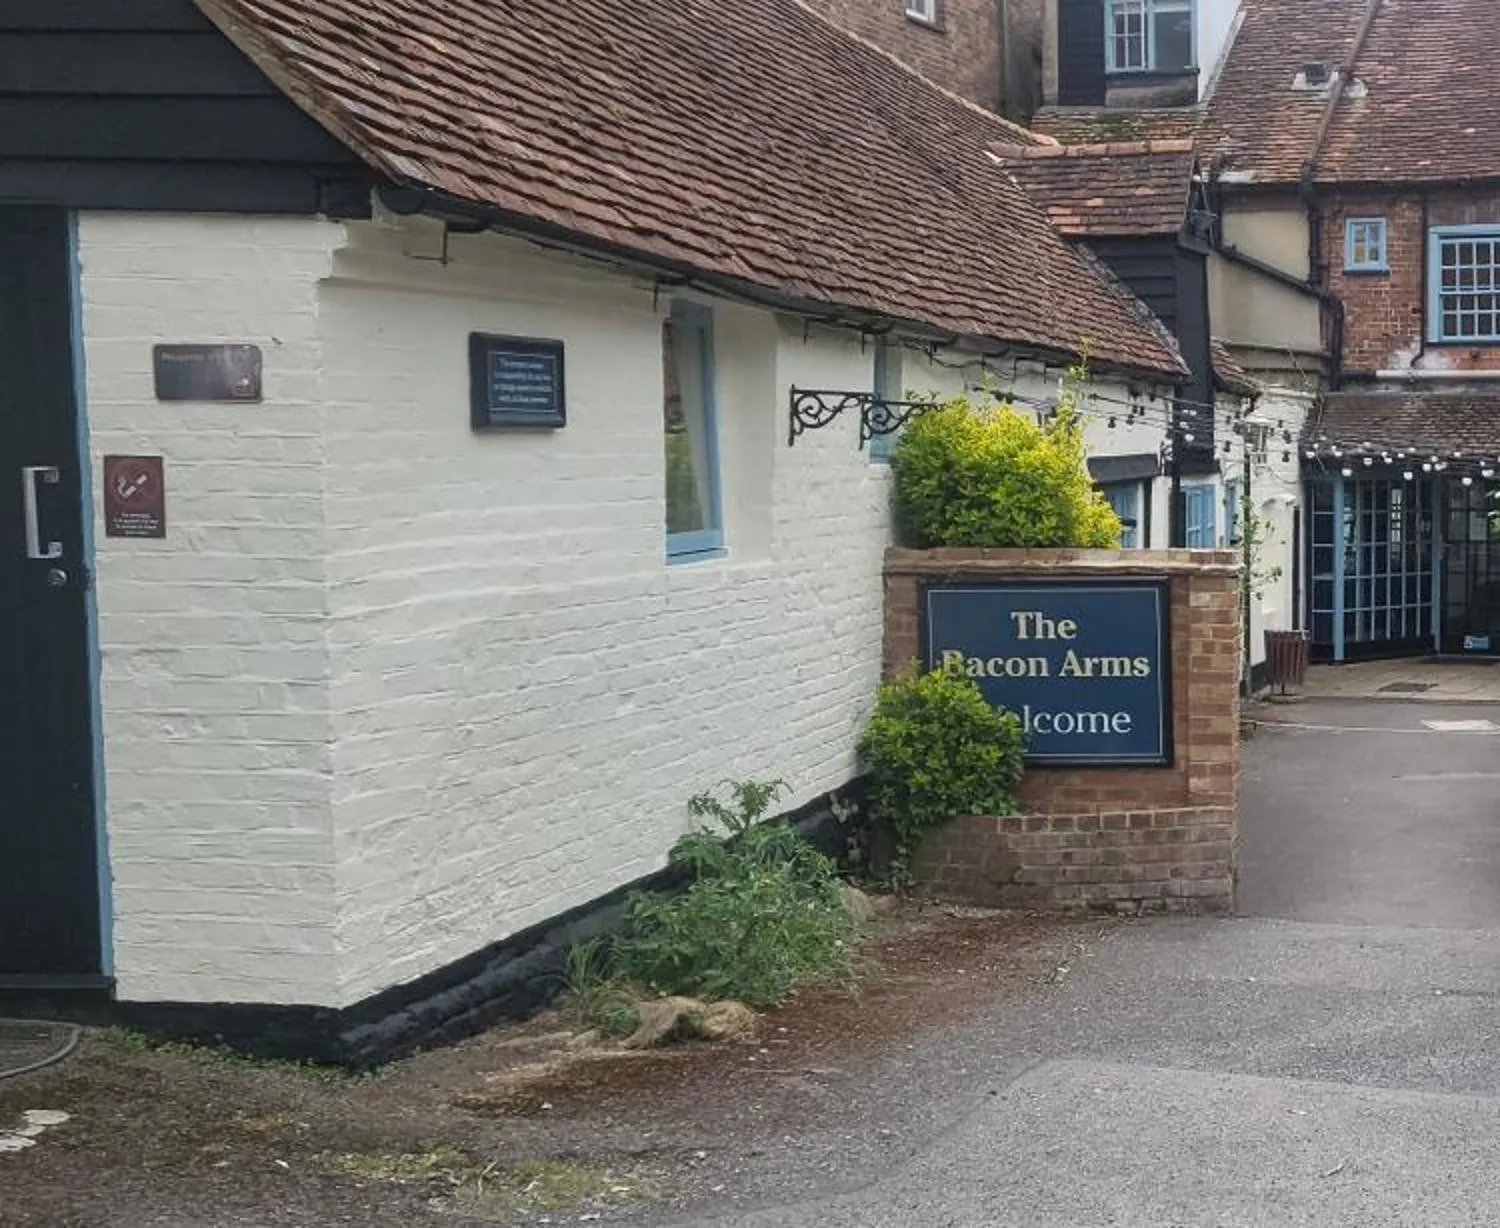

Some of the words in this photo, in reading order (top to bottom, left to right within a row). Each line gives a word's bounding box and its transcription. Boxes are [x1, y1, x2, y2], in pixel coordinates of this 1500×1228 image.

[1010, 611, 1077, 639] The
[942, 649, 1050, 677] Bacon
[1058, 649, 1151, 677] Arms
[1001, 704, 1132, 734] lcome
